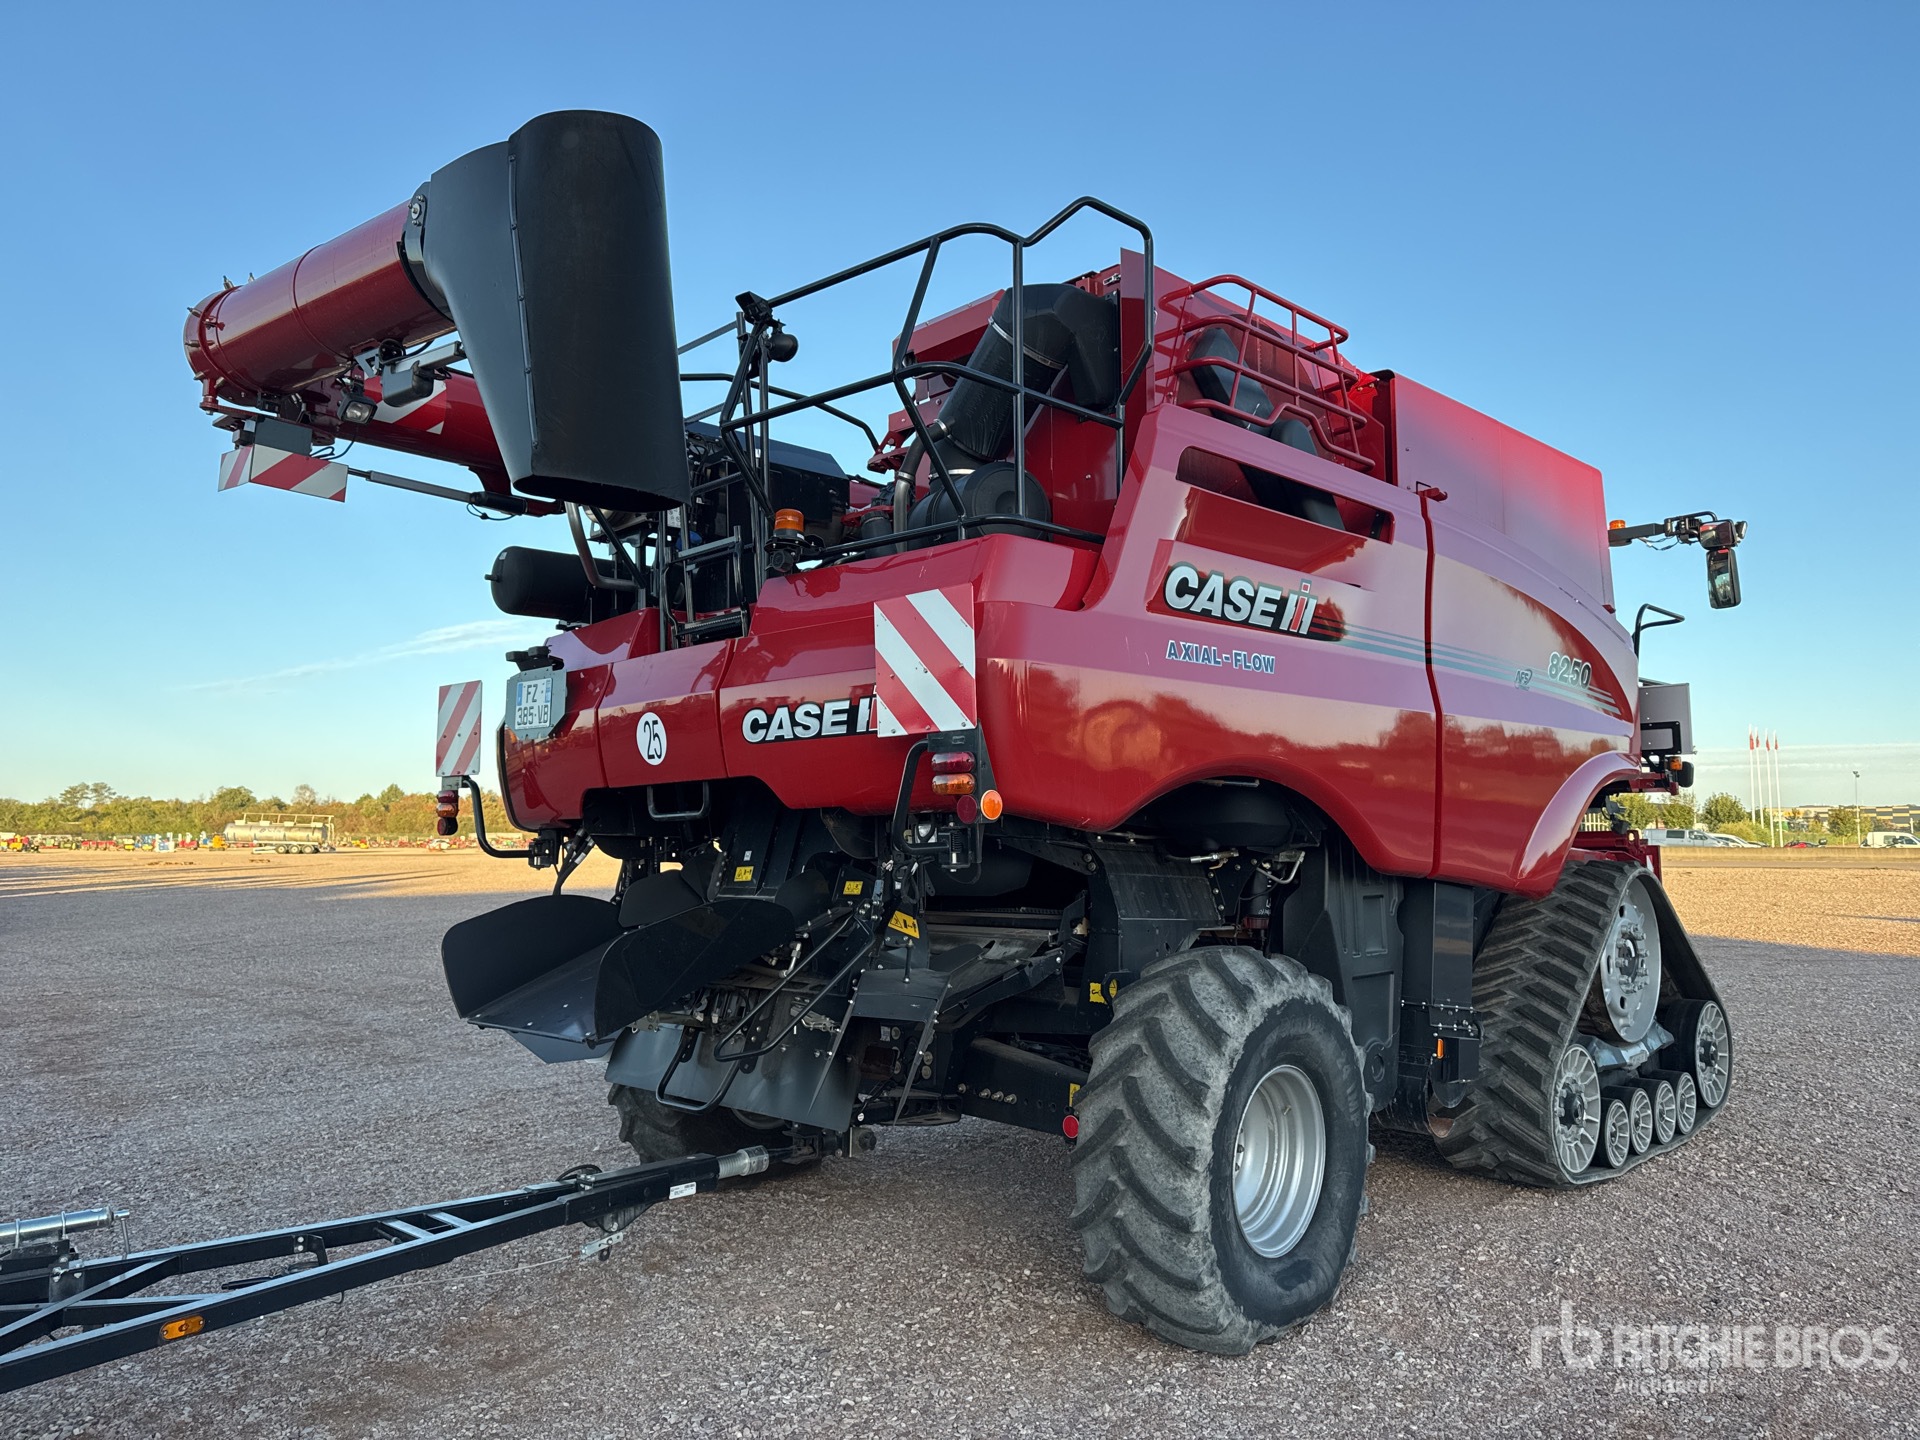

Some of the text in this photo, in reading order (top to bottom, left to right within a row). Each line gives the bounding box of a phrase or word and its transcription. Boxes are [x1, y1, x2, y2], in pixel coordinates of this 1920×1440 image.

[1165, 565, 1281, 627] CASE
[1166, 640, 1275, 674] AXIAL-FLOW
[1548, 651, 1592, 689] 8250
[526, 684, 538, 703] FZ
[643, 719, 663, 760] 25
[742, 700, 850, 742] CASE
